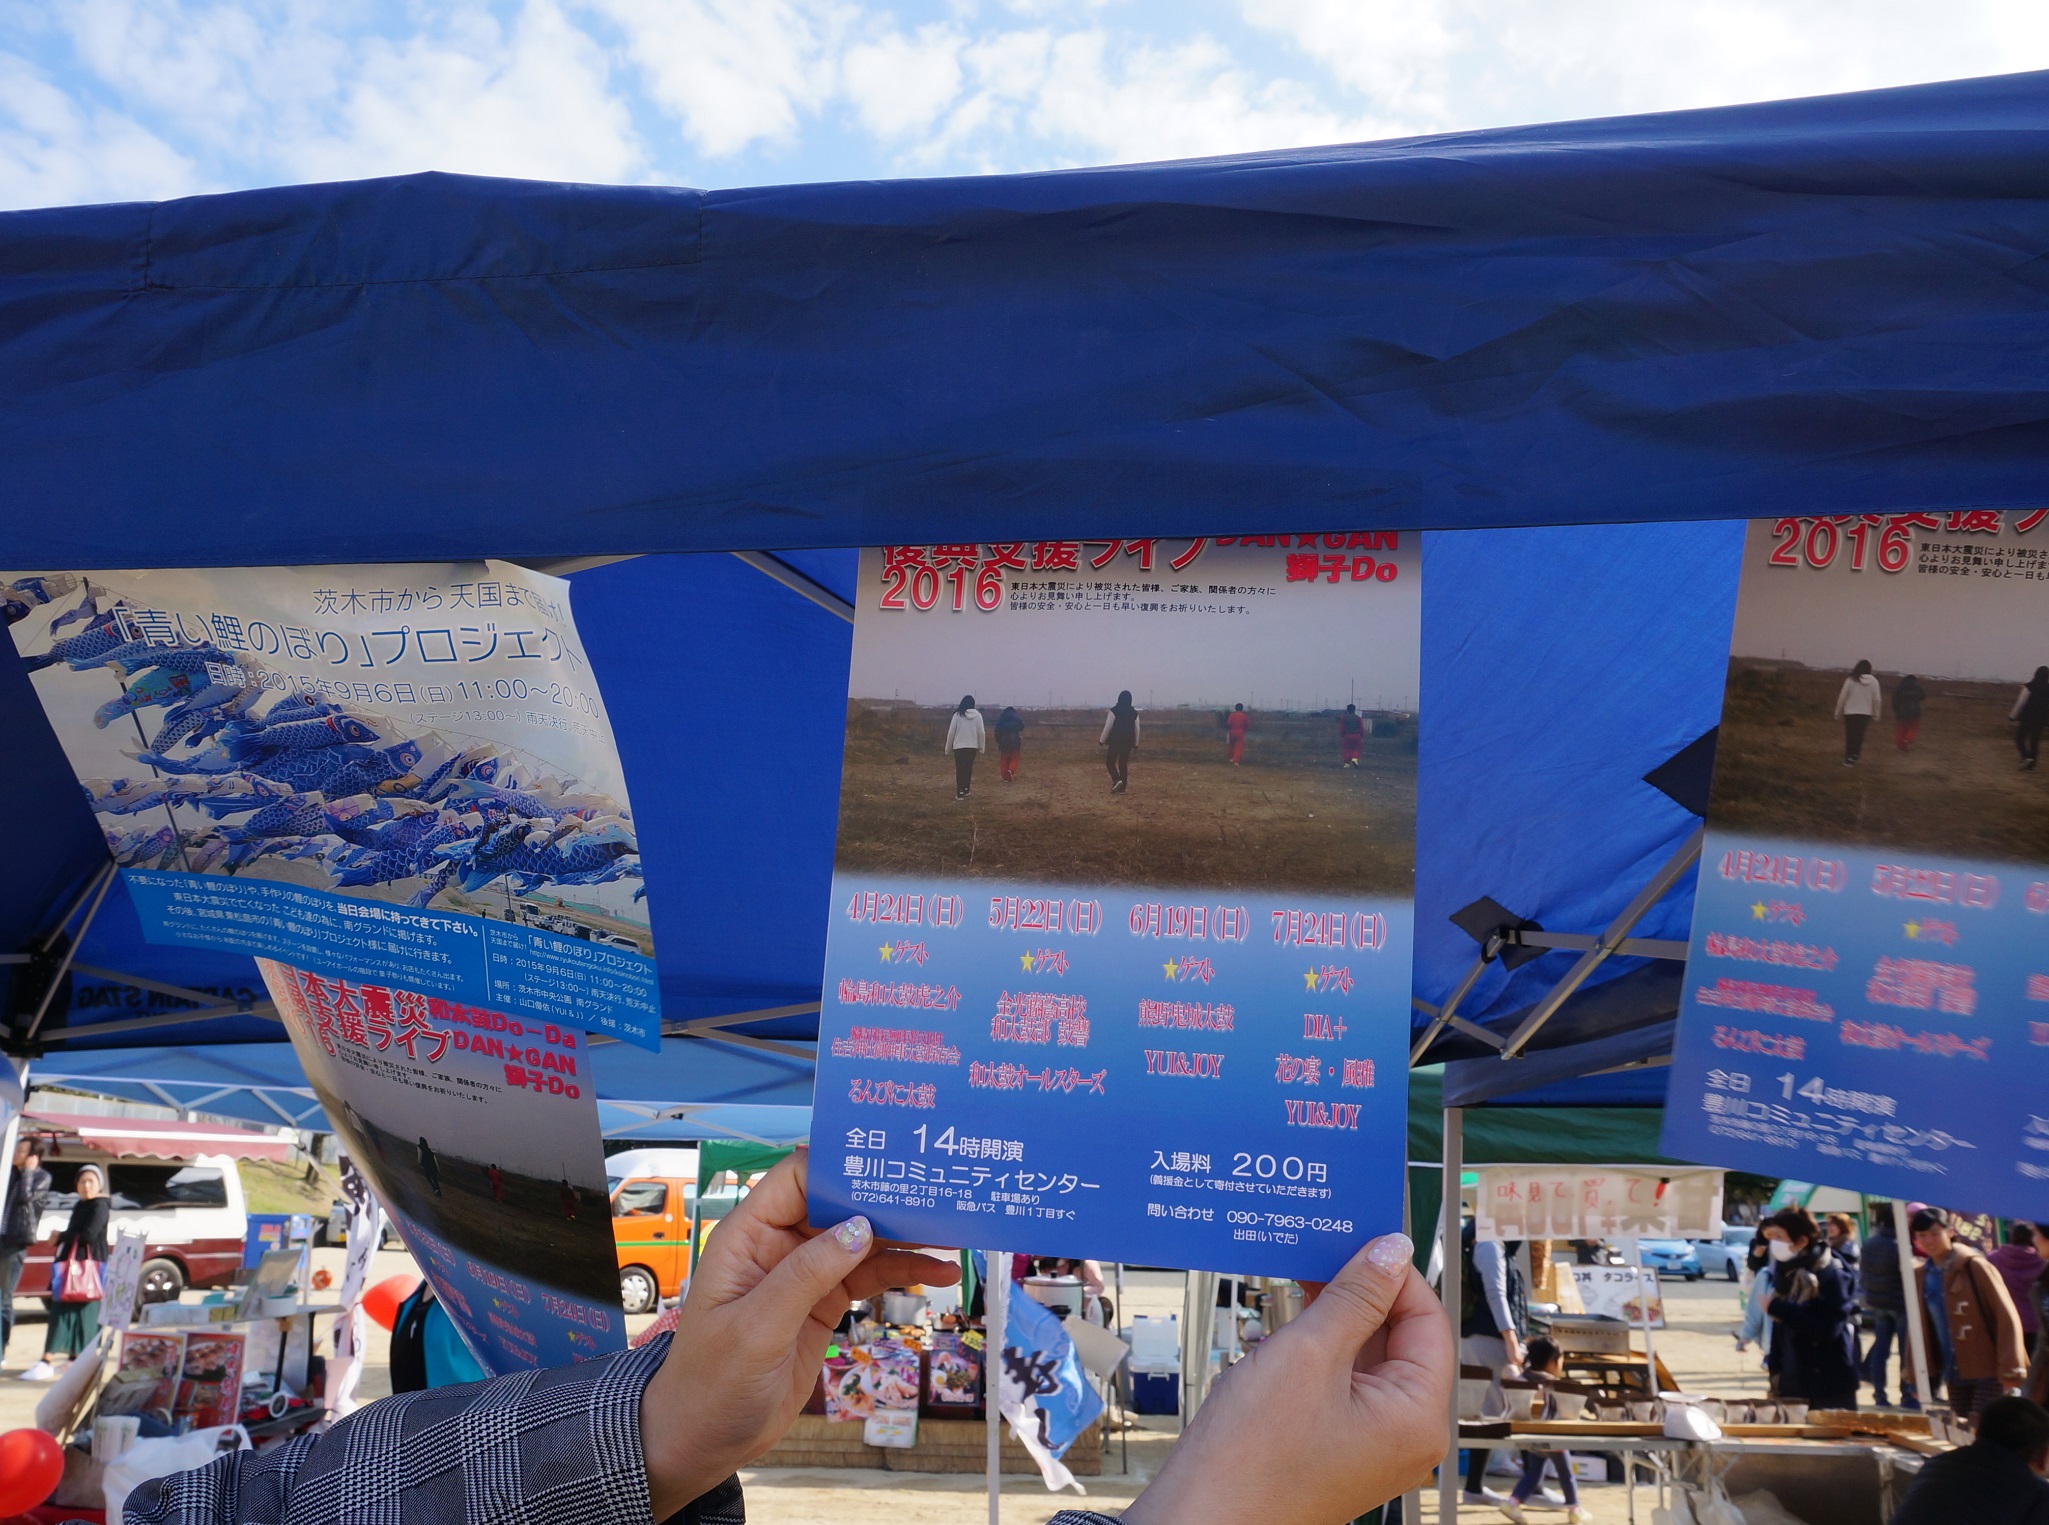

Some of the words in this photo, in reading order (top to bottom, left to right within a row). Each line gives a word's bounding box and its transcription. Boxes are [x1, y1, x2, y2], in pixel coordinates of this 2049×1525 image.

[1769, 517, 1912, 573] 2016
[1918, 553, 2049, 570] 心よりお見舞い申し上げま
[879, 564, 1003, 611] 2016
[847, 890, 964, 928] 4月24日(日)
[988, 896, 1103, 934] 5月22日(日)
[1129, 903, 1249, 942] 6月19日(日)
[1271, 909, 1387, 950] 7月24日(日)
[969, 1061, 1107, 1094] 和太鼓オールスターズ
[1144, 1049, 1224, 1078] YUI&JOY
[1285, 1099, 1362, 1129] YUI&JOY
[845, 1127, 886, 1150] 全日
[913, 1123, 1024, 1163] 14時開演
[843, 1155, 1101, 1194] 豊川コミュニティセンター
[1150, 1150, 1211, 1174] 入場料
[851, 1191, 935, 1208] (072)641-8910
[990, 1191, 1040, 1205] 駐車場あり
[1147, 1203, 1214, 1222] 問い合わせ
[1226, 1210, 1354, 1233] 090-7963-0248
[1604, 1272, 1655, 1283] タコラス
